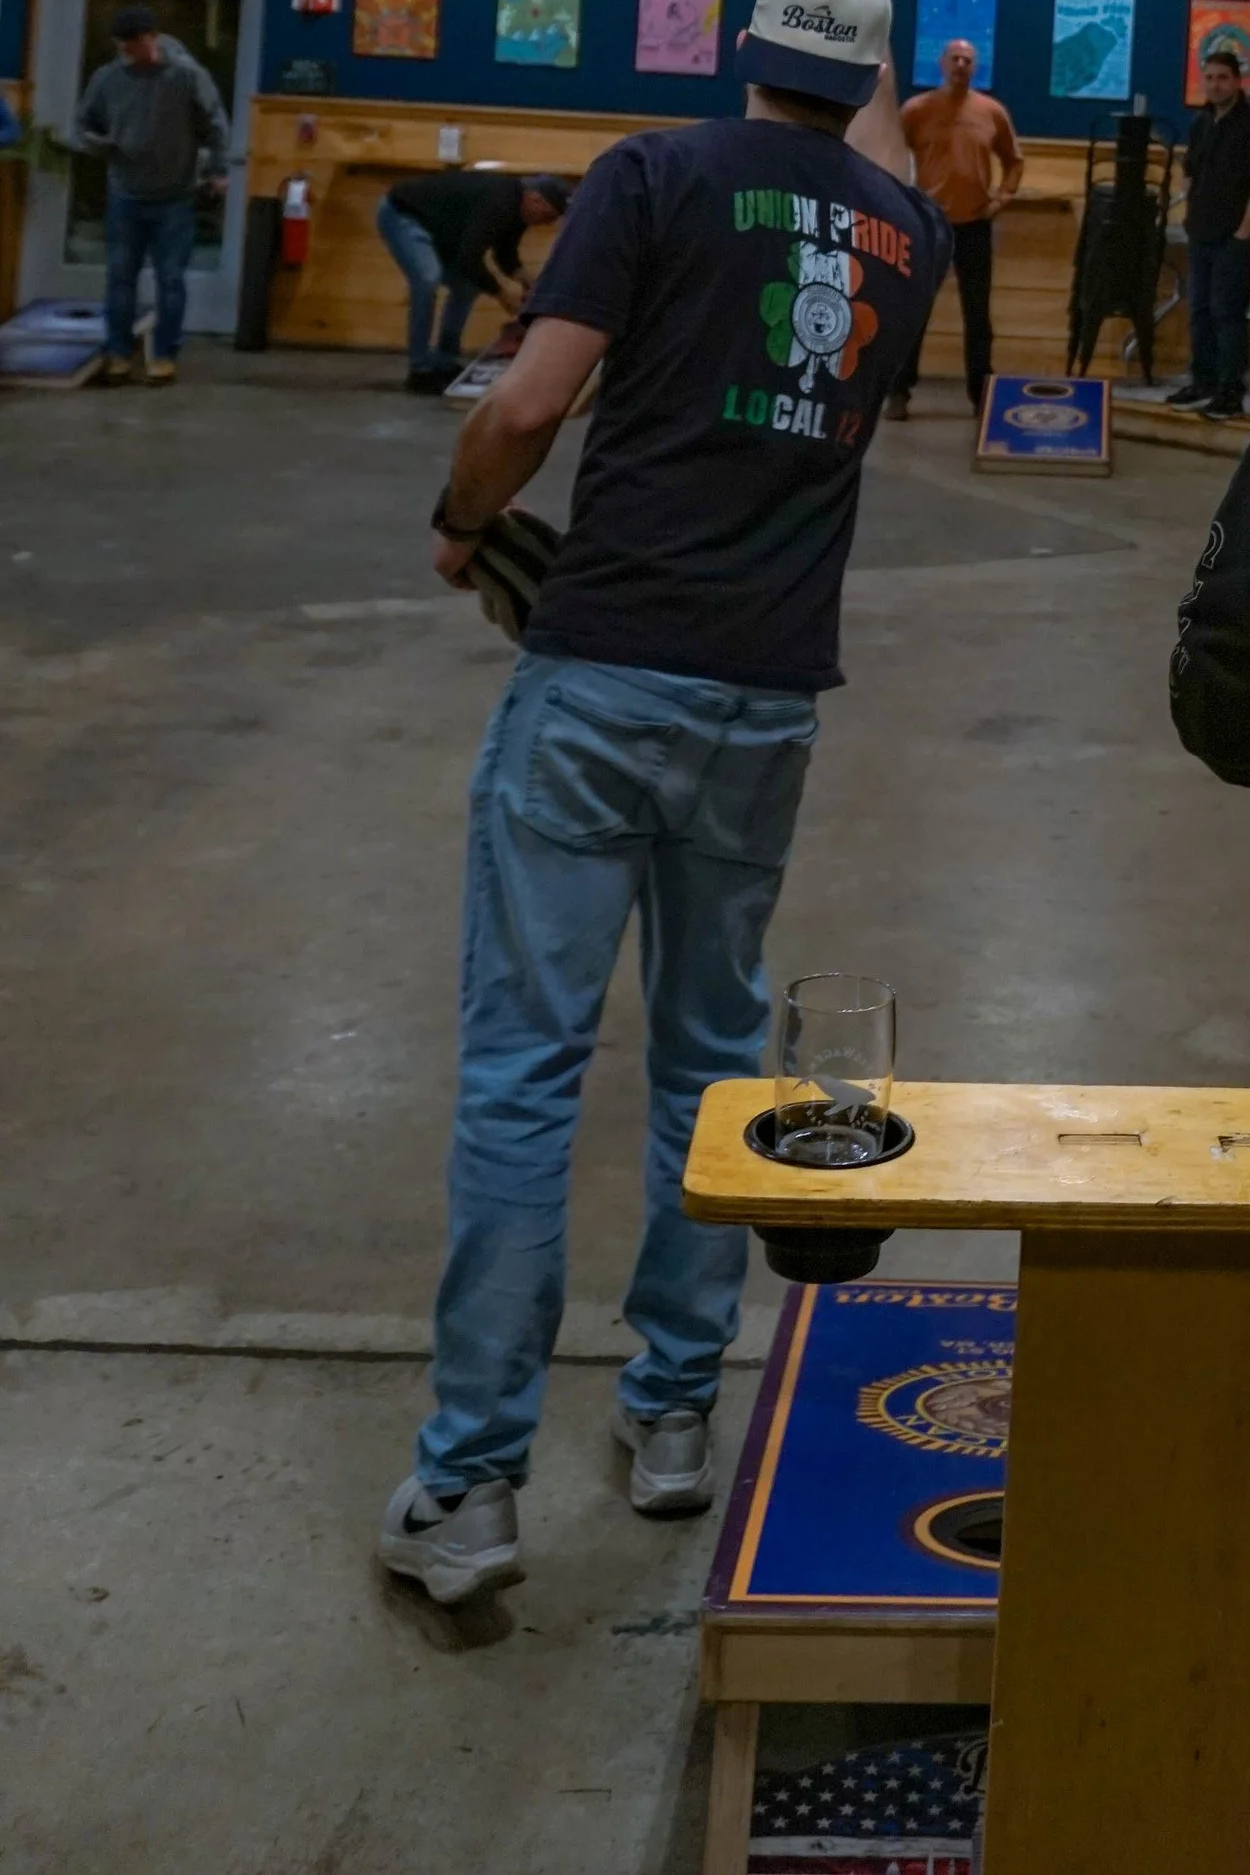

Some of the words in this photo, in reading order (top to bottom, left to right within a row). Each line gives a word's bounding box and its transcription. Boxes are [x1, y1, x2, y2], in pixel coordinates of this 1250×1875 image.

[781, 4, 857, 37] Boston
[733, 188, 820, 238] UNION
[829, 201, 912, 277] PRIDE
[723, 382, 828, 440] LOCAL
